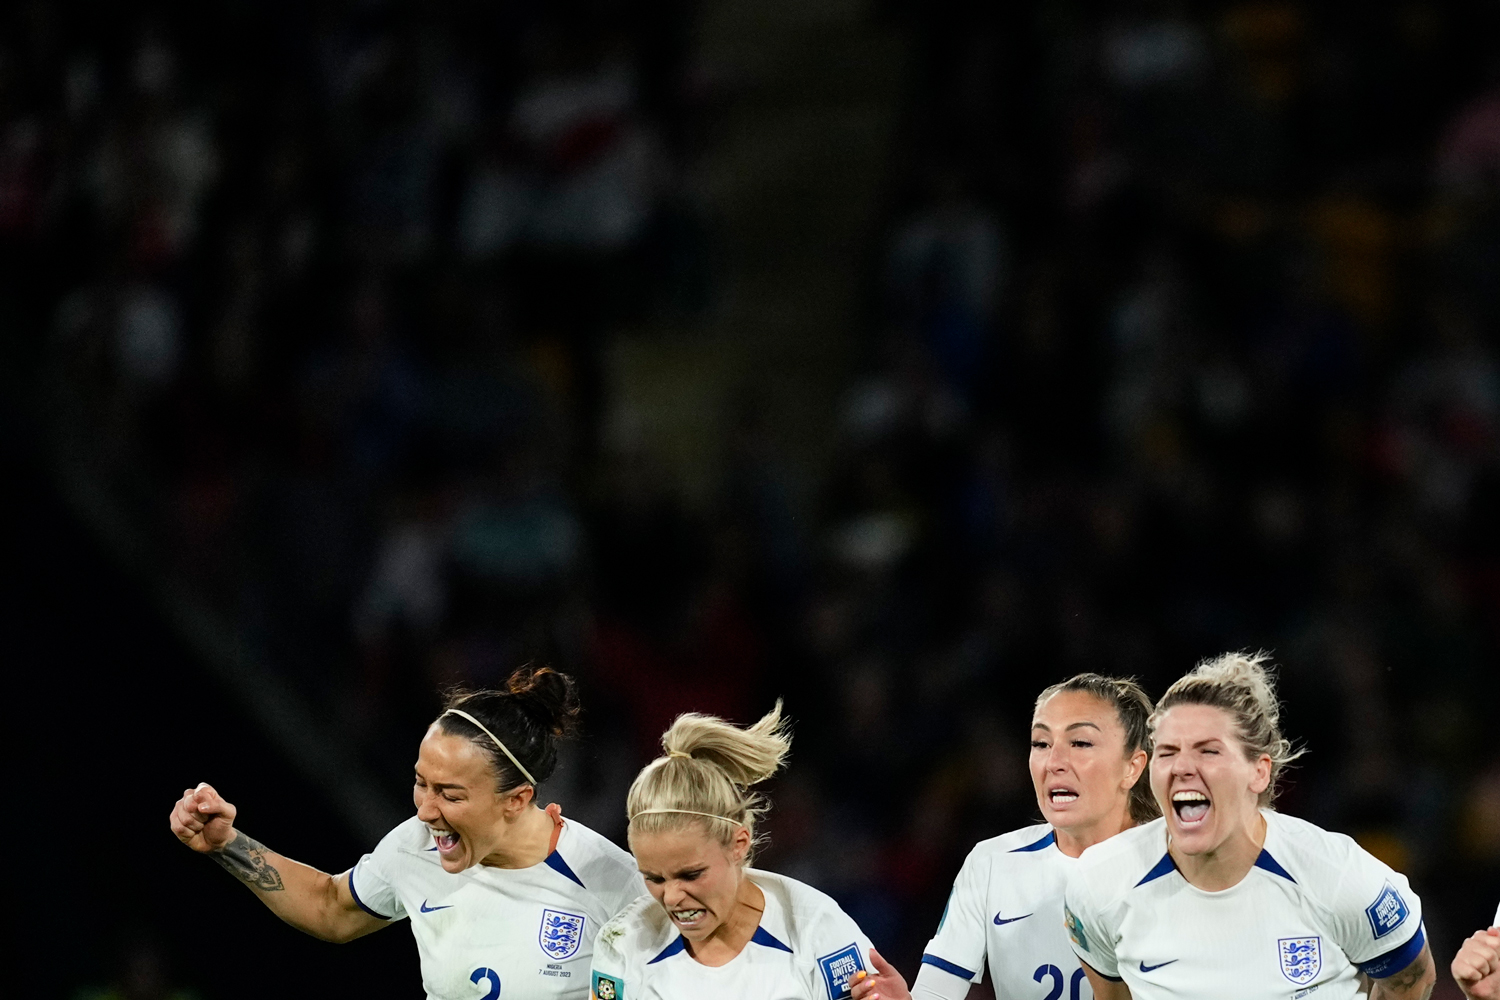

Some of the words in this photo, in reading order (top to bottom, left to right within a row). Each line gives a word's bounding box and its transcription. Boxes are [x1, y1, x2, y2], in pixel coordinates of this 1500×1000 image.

[1378, 899, 1399, 919] UNITES
[829, 954, 855, 970] FOOTBALL
[831, 961, 857, 979] UNITES
[542, 969, 559, 977] AUGUST
